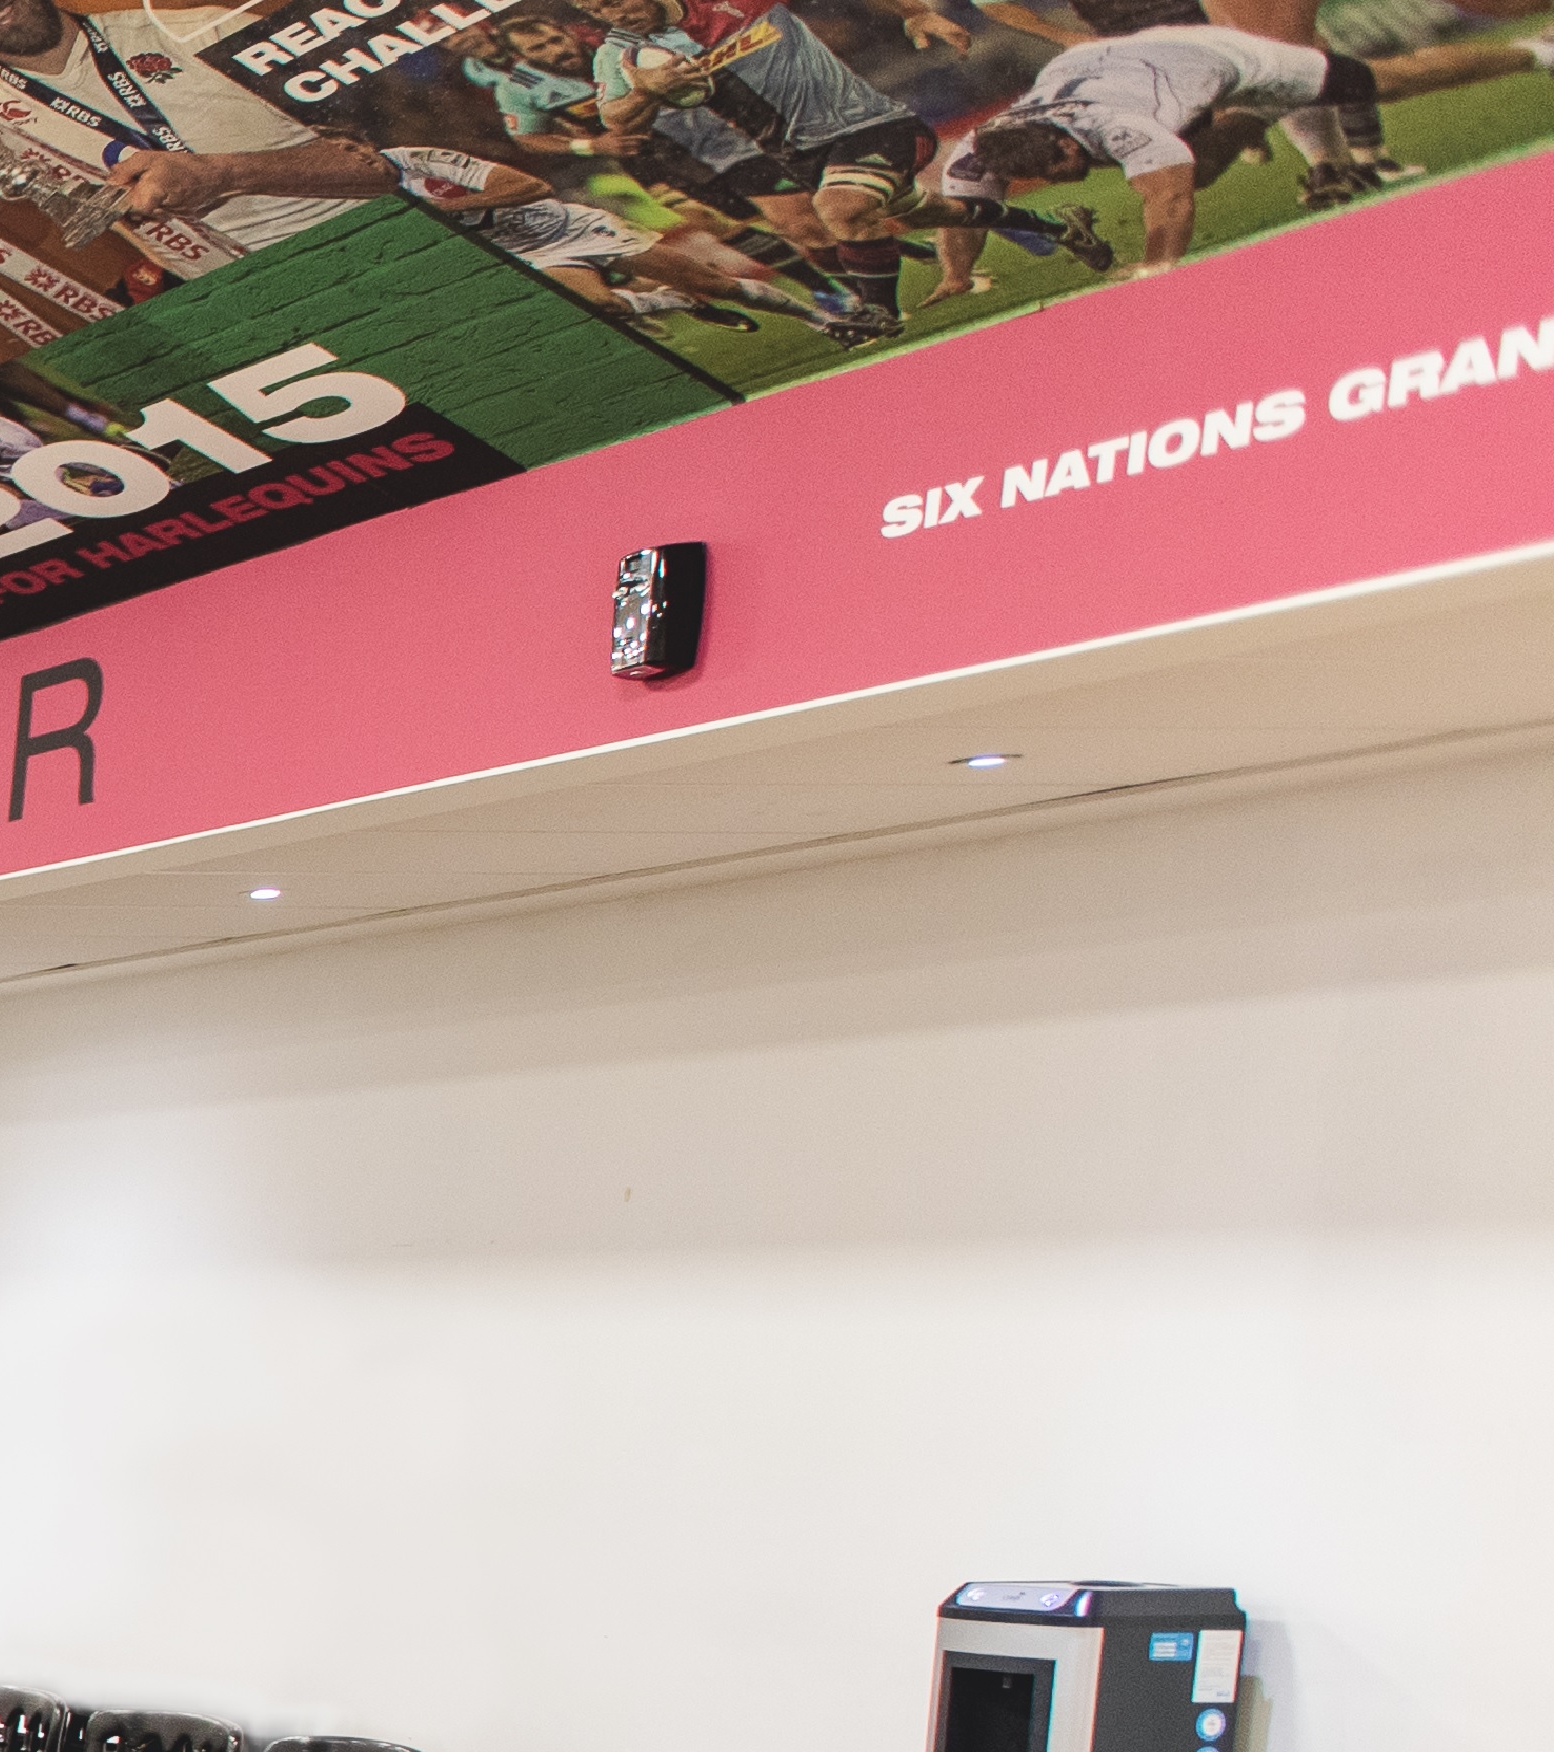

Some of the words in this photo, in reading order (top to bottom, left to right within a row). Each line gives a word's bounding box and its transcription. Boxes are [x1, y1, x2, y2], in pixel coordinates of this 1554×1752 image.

[284, 0, 522, 103] CHALL
[146, 222, 210, 260] RBS
[78, 431, 456, 570] HARLEQUINS
[879, 476, 989, 540] SIX
[998, 389, 1306, 510] NATIONS
